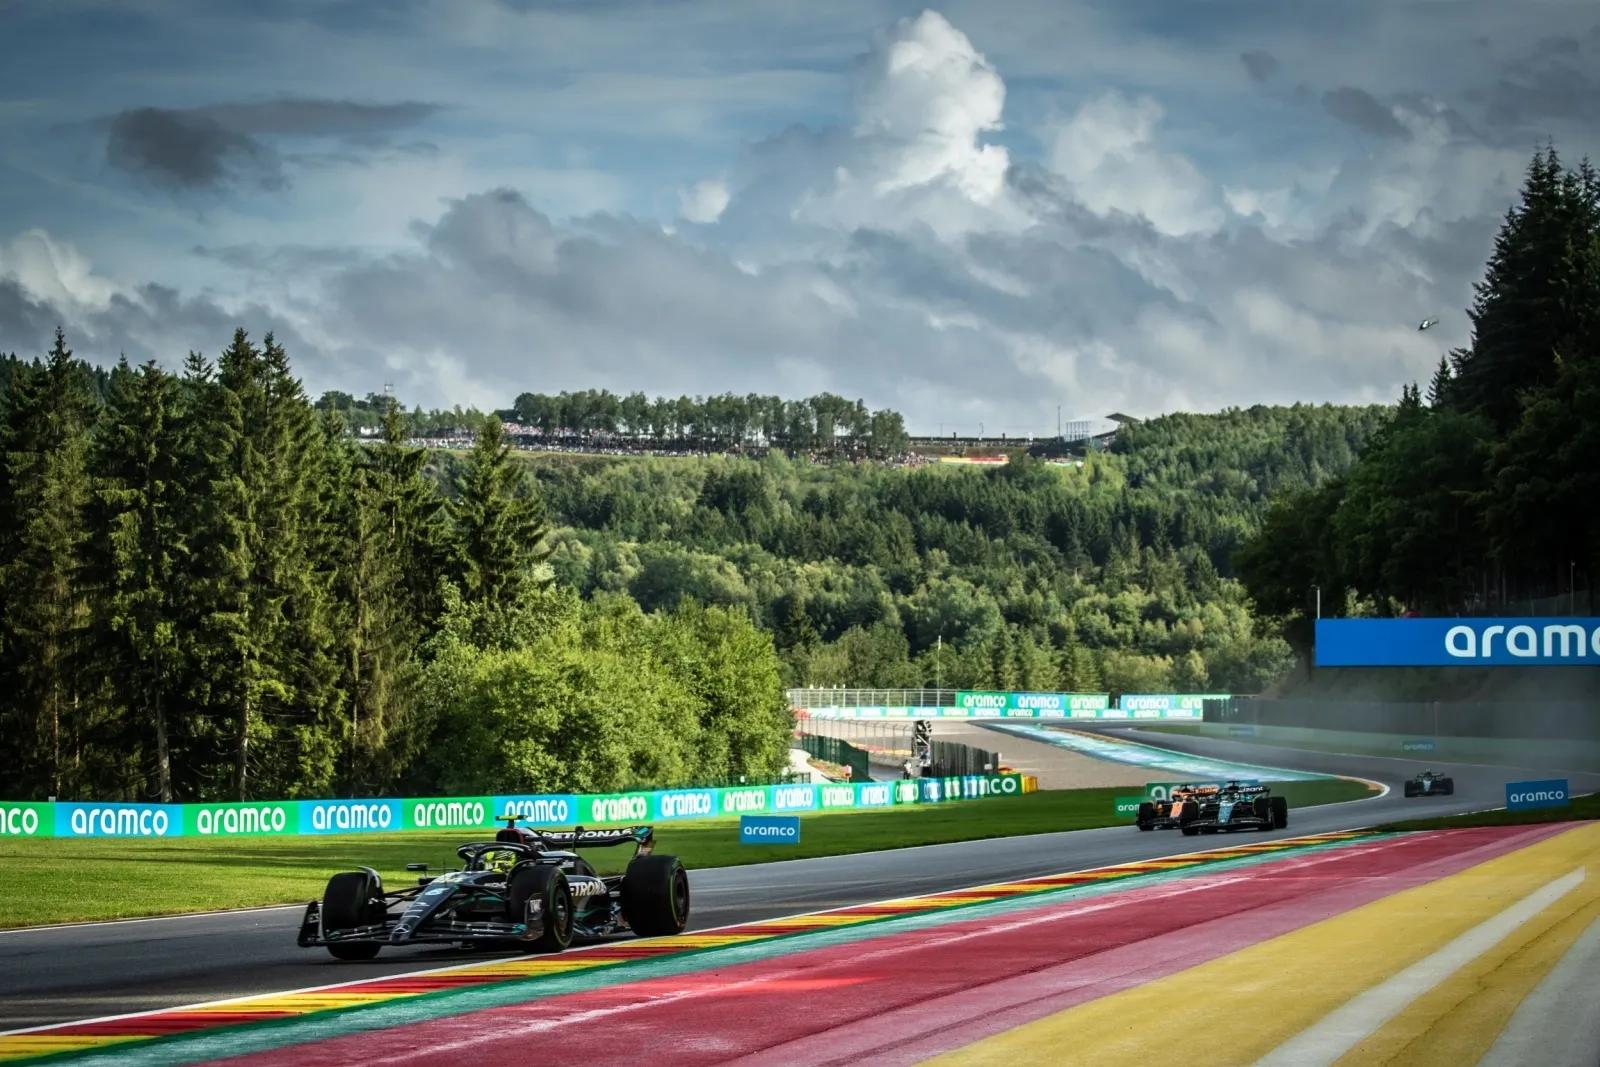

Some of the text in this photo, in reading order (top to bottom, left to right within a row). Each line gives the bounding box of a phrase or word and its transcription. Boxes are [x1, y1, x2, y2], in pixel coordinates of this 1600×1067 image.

[964, 695, 1006, 708] aramco
[1007, 708, 1033, 717] aramco
[1018, 696, 1059, 709] aramco
[1127, 697, 1169, 709] aramco
[661, 792, 711, 817] aramco
[724, 789, 765, 812] aramco
[776, 786, 813, 808] aramco
[1510, 789, 1565, 803] aramco
[197, 806, 285, 834] aramco
[312, 804, 391, 830] aramco
[414, 801, 484, 827] aramco
[505, 799, 568, 822] aramco
[592, 796, 647, 822] aramco
[71, 808, 168, 836] aramco
[744, 826, 796, 837] aramco
